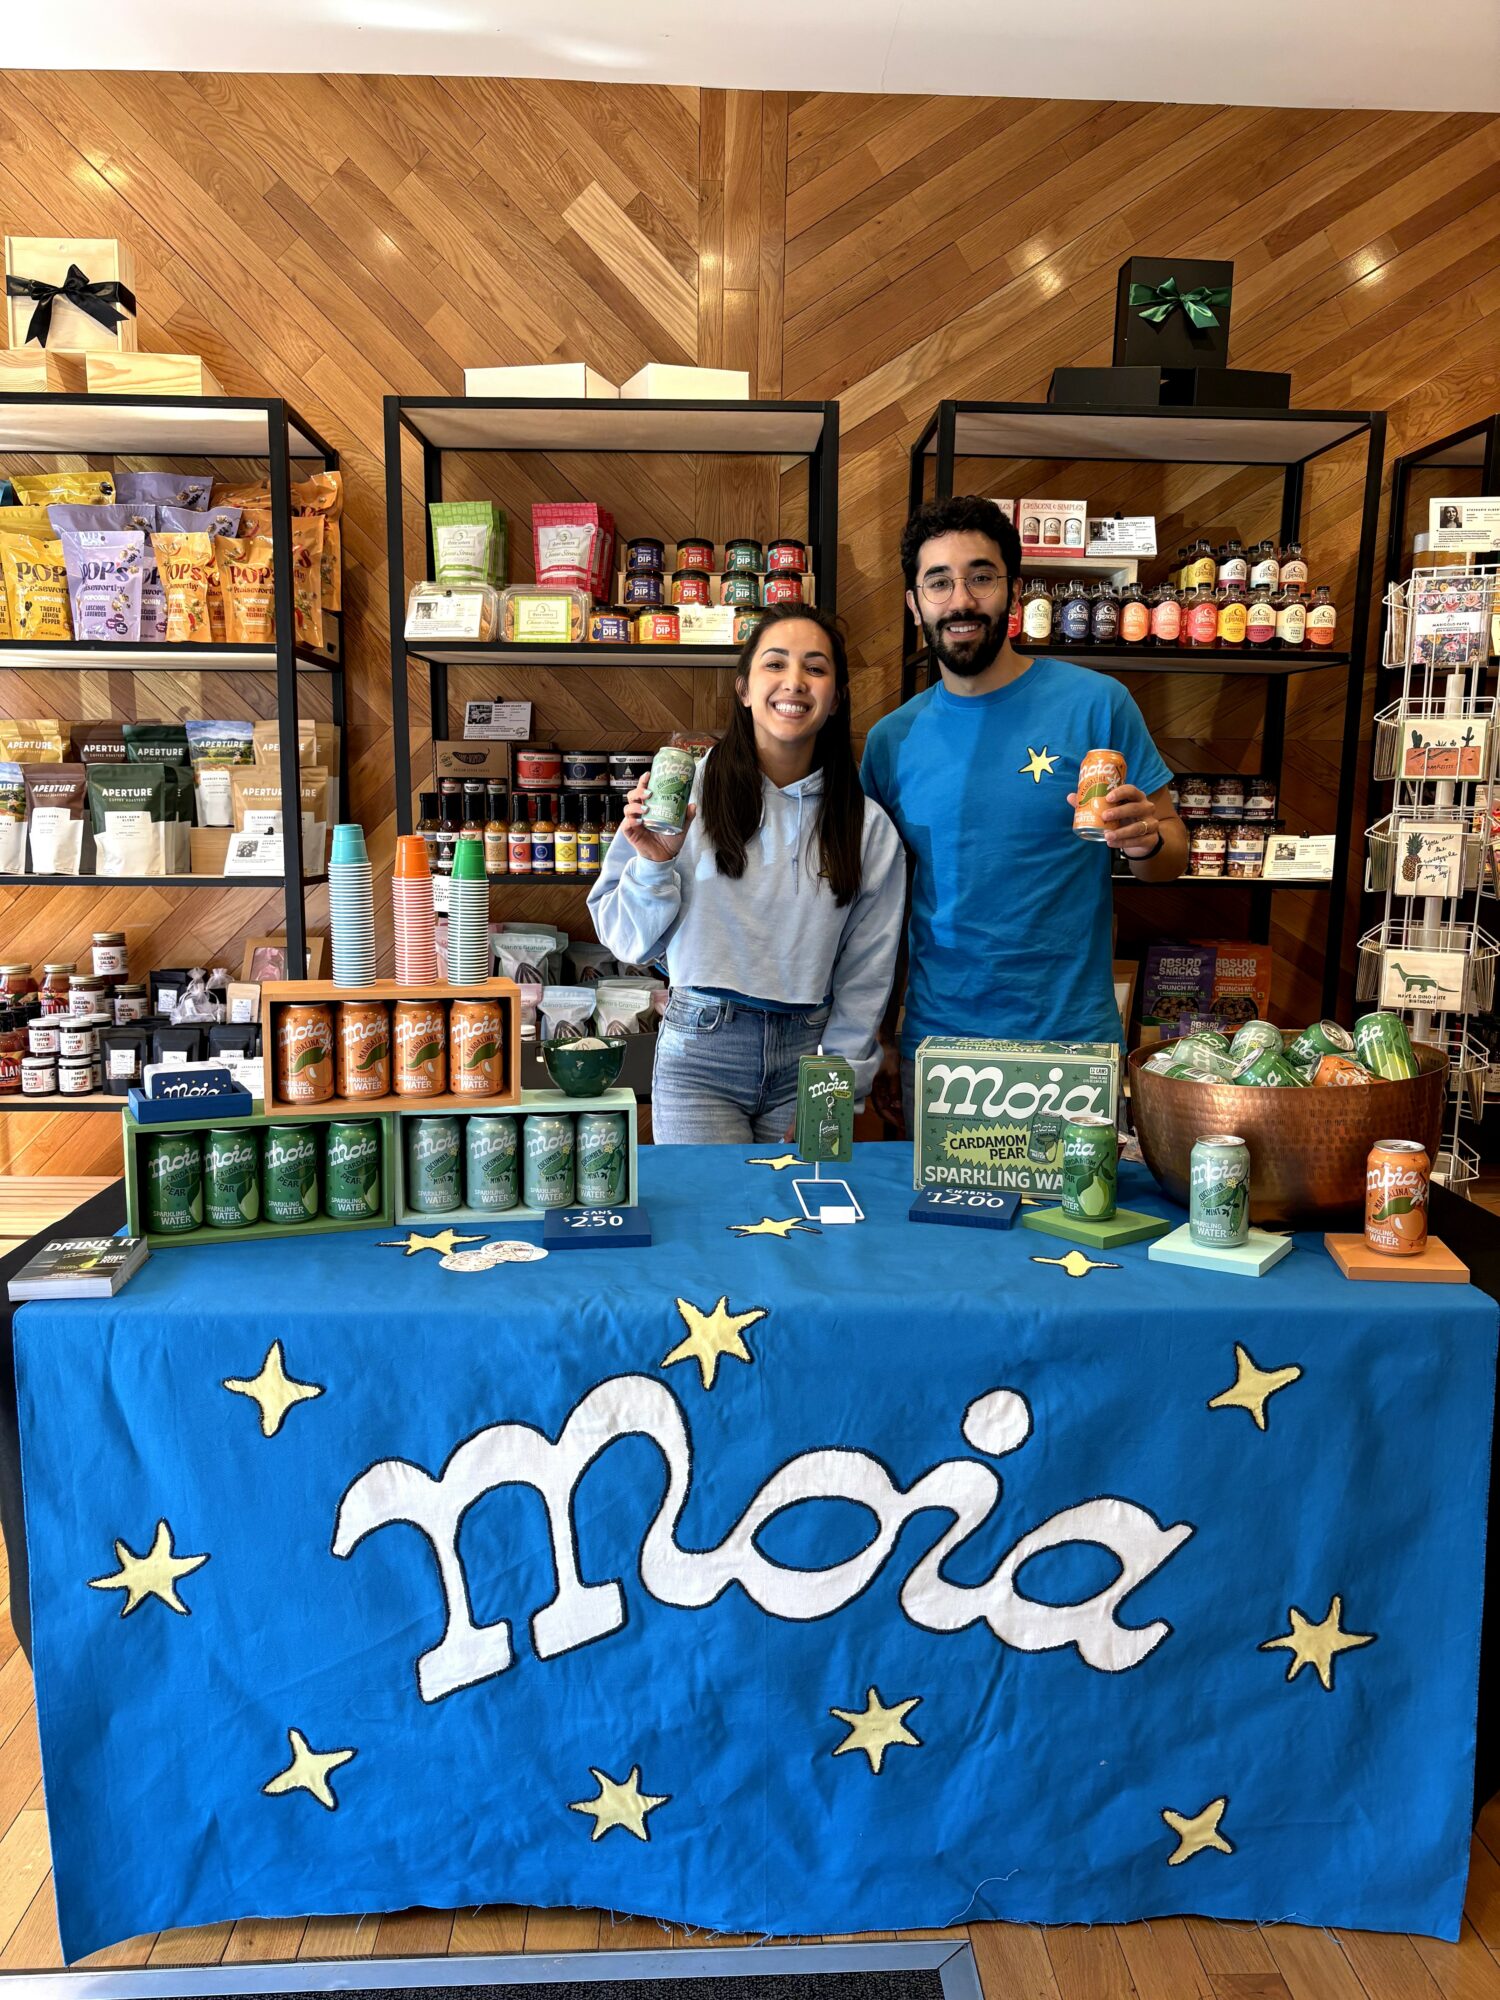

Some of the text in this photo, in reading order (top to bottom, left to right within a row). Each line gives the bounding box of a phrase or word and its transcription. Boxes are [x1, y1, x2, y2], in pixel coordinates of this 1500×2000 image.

[779, 556, 794, 564] DIP
[683, 589, 697, 597] DIP
[735, 590, 750, 598] DIP
[1432, 594, 1467, 604] NOTES
[602, 628, 618, 636] DIP
[7, 740, 53, 750] APERTURE
[199, 740, 245, 748] APERTURE
[137, 748, 184, 756] APERTURE
[32, 784, 77, 793] APERTURE
[102, 787, 153, 797] APERTURE
[650, 808, 675, 819] WATER
[1160, 958, 1202, 967] ABSURD
[1215, 958, 1257, 968] ABSURD
[1159, 967, 1201, 976] SNACKS
[1215, 967, 1257, 977] SNACKS
[353, 1081, 382, 1091] WATER
[405, 1080, 432, 1088] WATER
[461, 1080, 489, 1088] WATER
[809, 1078, 849, 1098] moia
[287, 1087, 315, 1095] WATER
[926, 1064, 1105, 1121] moia
[950, 1134, 1027, 1150] CARDAMOM
[990, 1147, 1026, 1160] PEAR
[537, 1150, 562, 1170] CUCUMBER
[588, 1172, 600, 1180] MINT
[924, 1165, 1030, 1189] SPARKLING
[1191, 1159, 1242, 1186] moia
[490, 1175, 504, 1184] MINT
[1366, 1166, 1418, 1191] moia
[581, 1189, 606, 1199] WATER
[945, 1188, 993, 1196] CHARMS
[1198, 1183, 1226, 1200] CUCUMBER
[424, 1195, 452, 1204] WATER
[481, 1194, 509, 1203] WATER
[536, 1192, 564, 1201] WATER
[926, 1192, 1004, 1208] $12.00
[275, 1206, 305, 1215] WATER
[337, 1203, 367, 1212] WATER
[1205, 1208, 1220, 1216] MINT
[212, 1211, 241, 1220] WATER
[160, 1216, 192, 1225] WATER
[563, 1215, 624, 1228] $2.50
[1196, 1227, 1227, 1238] WATER
[1369, 1232, 1399, 1246] WATER
[44, 1238, 141, 1252] DRINK IT
[331, 1373, 1196, 1705] moia
